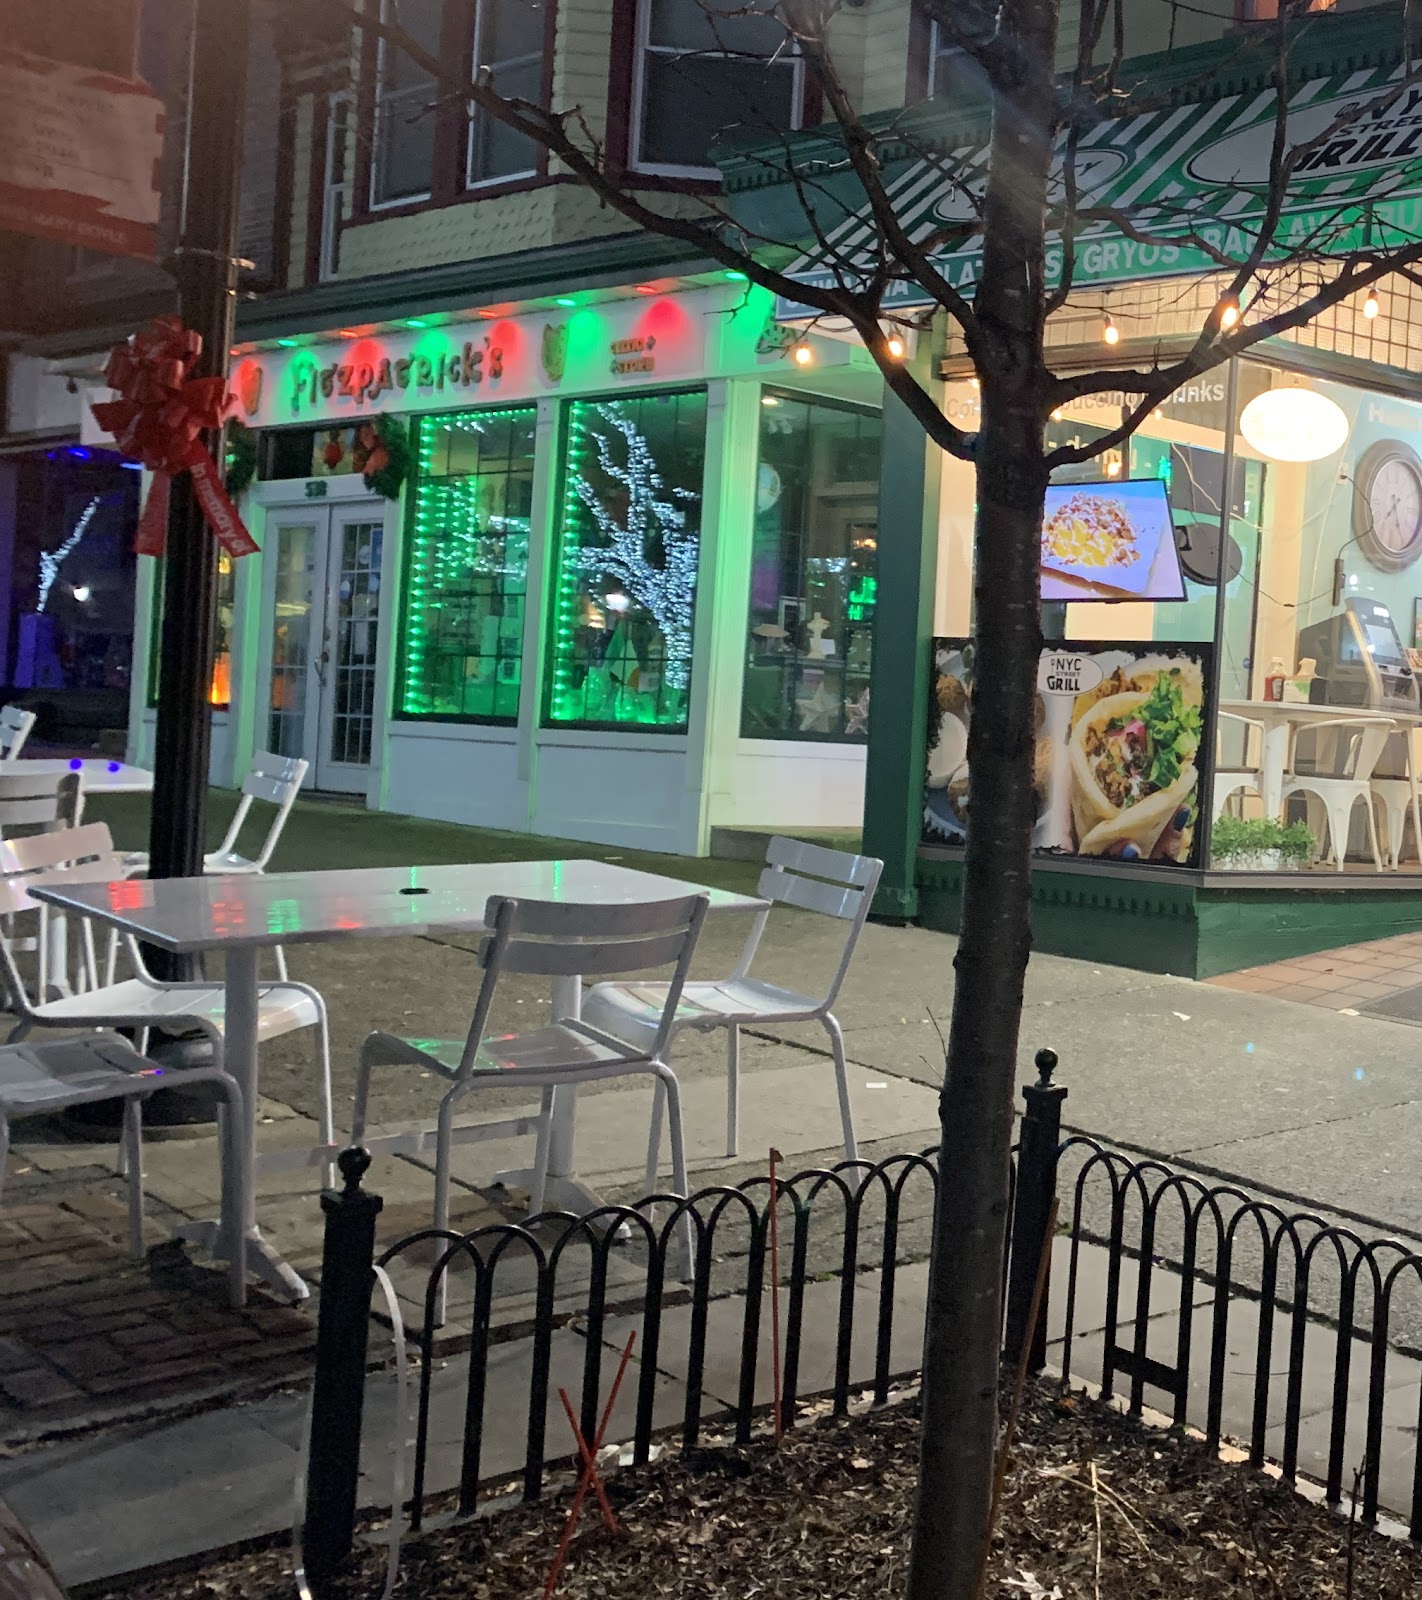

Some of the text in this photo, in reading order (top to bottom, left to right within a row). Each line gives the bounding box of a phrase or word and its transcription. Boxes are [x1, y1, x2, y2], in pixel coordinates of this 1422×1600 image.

[1201, 213, 1347, 258] BAKAVA
[1056, 658, 1081, 671] NYC
[1047, 675, 1080, 691] GRILL
